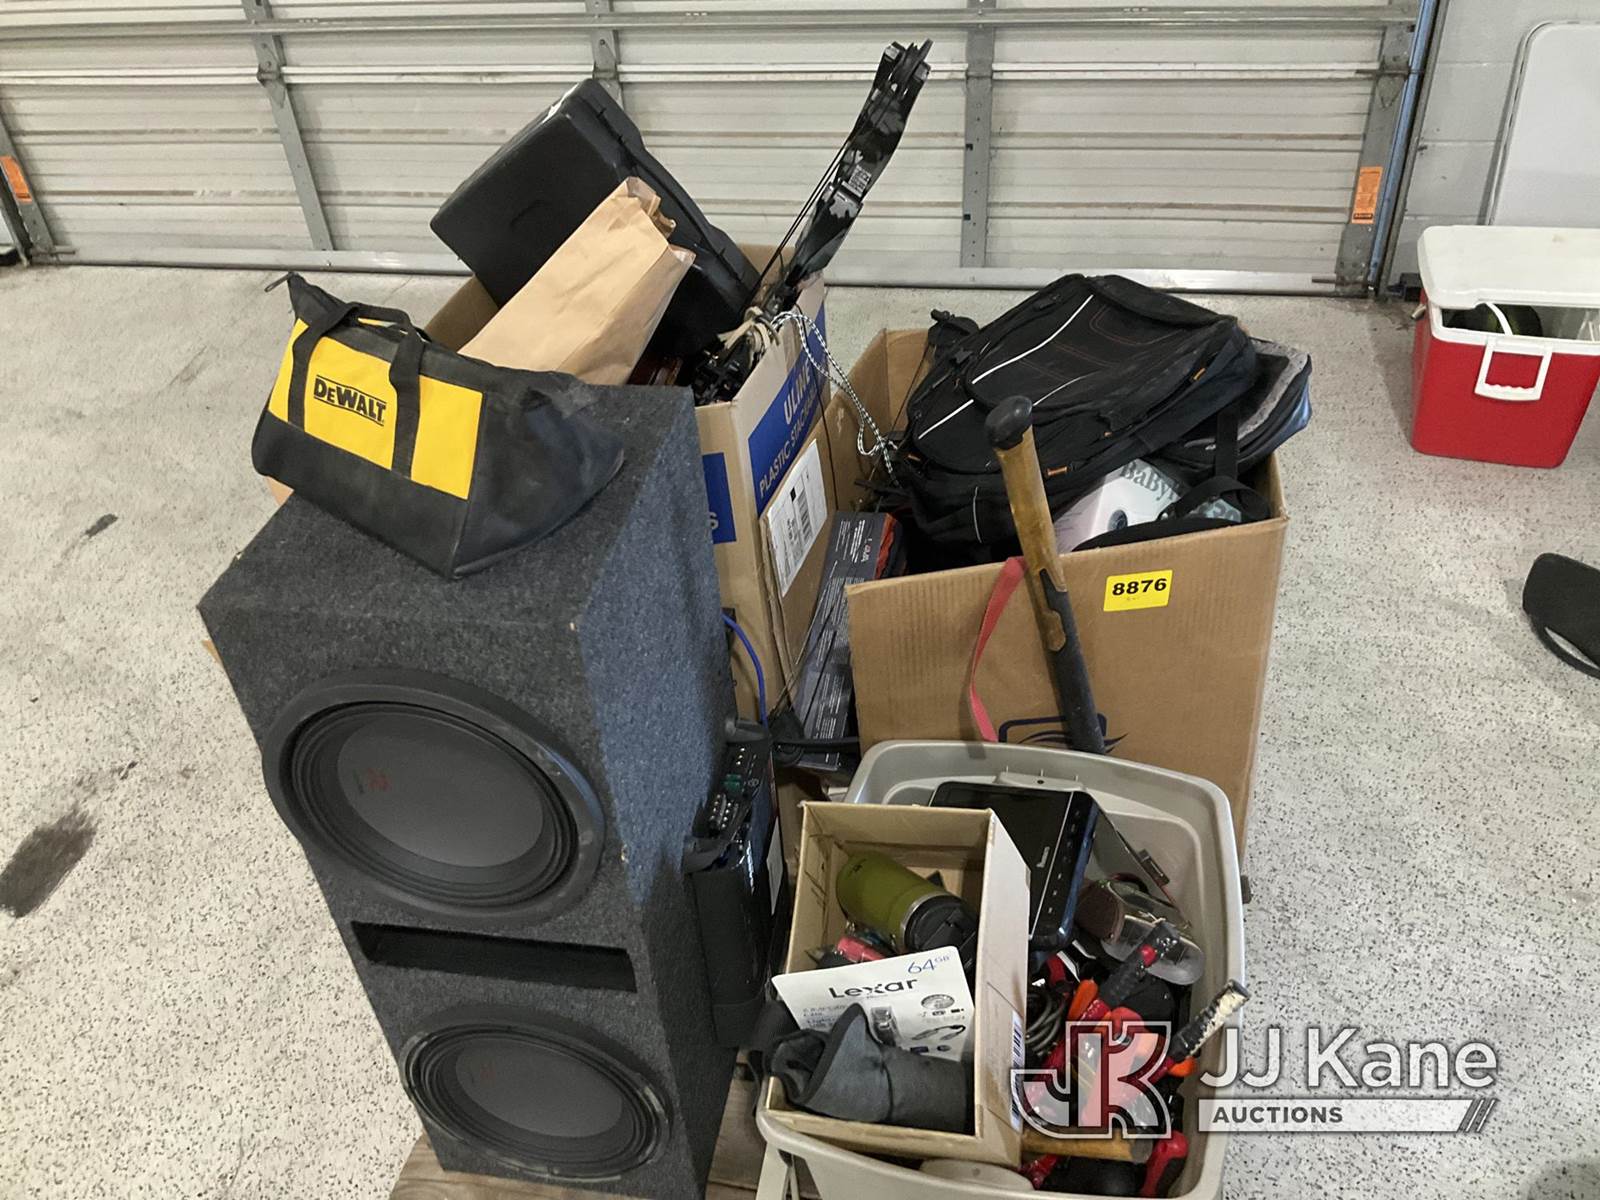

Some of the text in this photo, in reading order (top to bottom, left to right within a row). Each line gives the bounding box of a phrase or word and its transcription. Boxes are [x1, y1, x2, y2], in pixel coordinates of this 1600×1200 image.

[783, 356, 811, 425] ULINE
[759, 440, 792, 500] PLASTIC
[1111, 578, 1168, 596] 8876
[828, 978, 918, 999] Lexar
